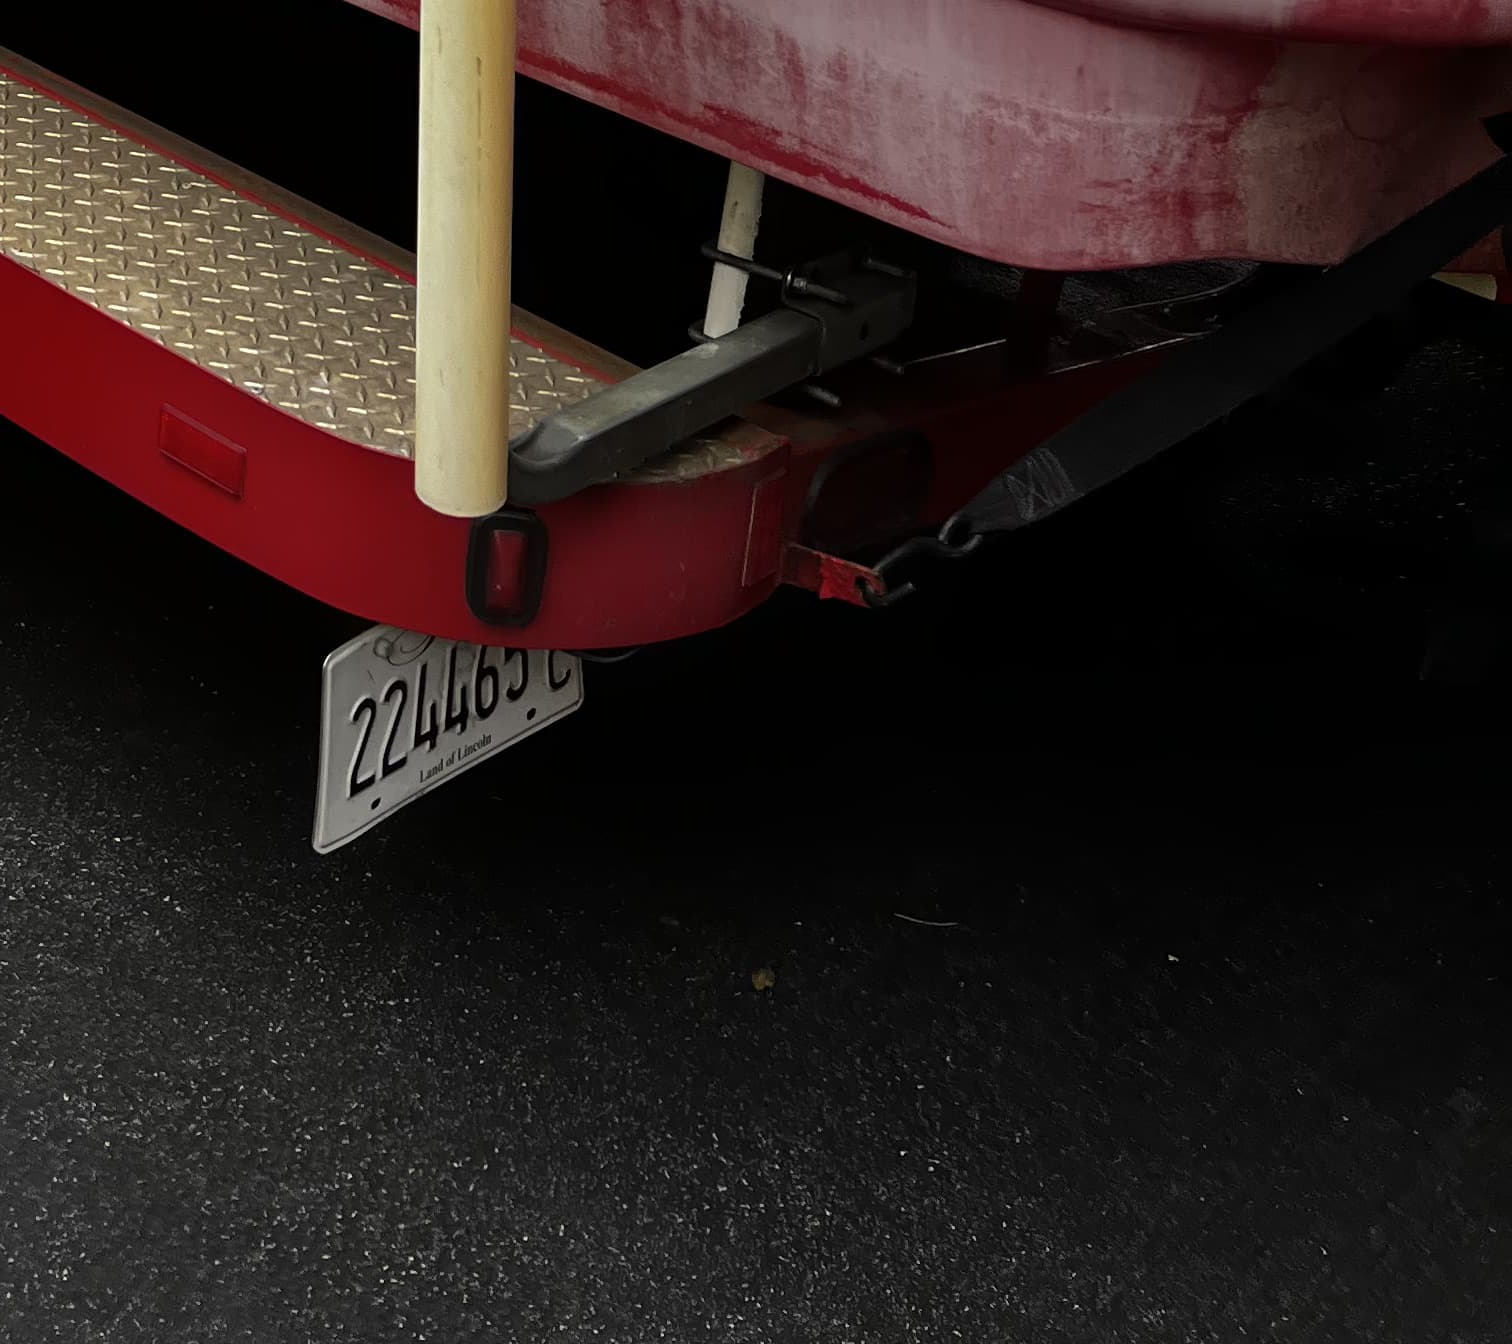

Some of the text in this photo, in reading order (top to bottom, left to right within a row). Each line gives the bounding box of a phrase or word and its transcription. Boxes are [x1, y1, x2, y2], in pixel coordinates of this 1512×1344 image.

[347, 642, 530, 799] 224465
[419, 733, 492, 784] Land of Lincoln
